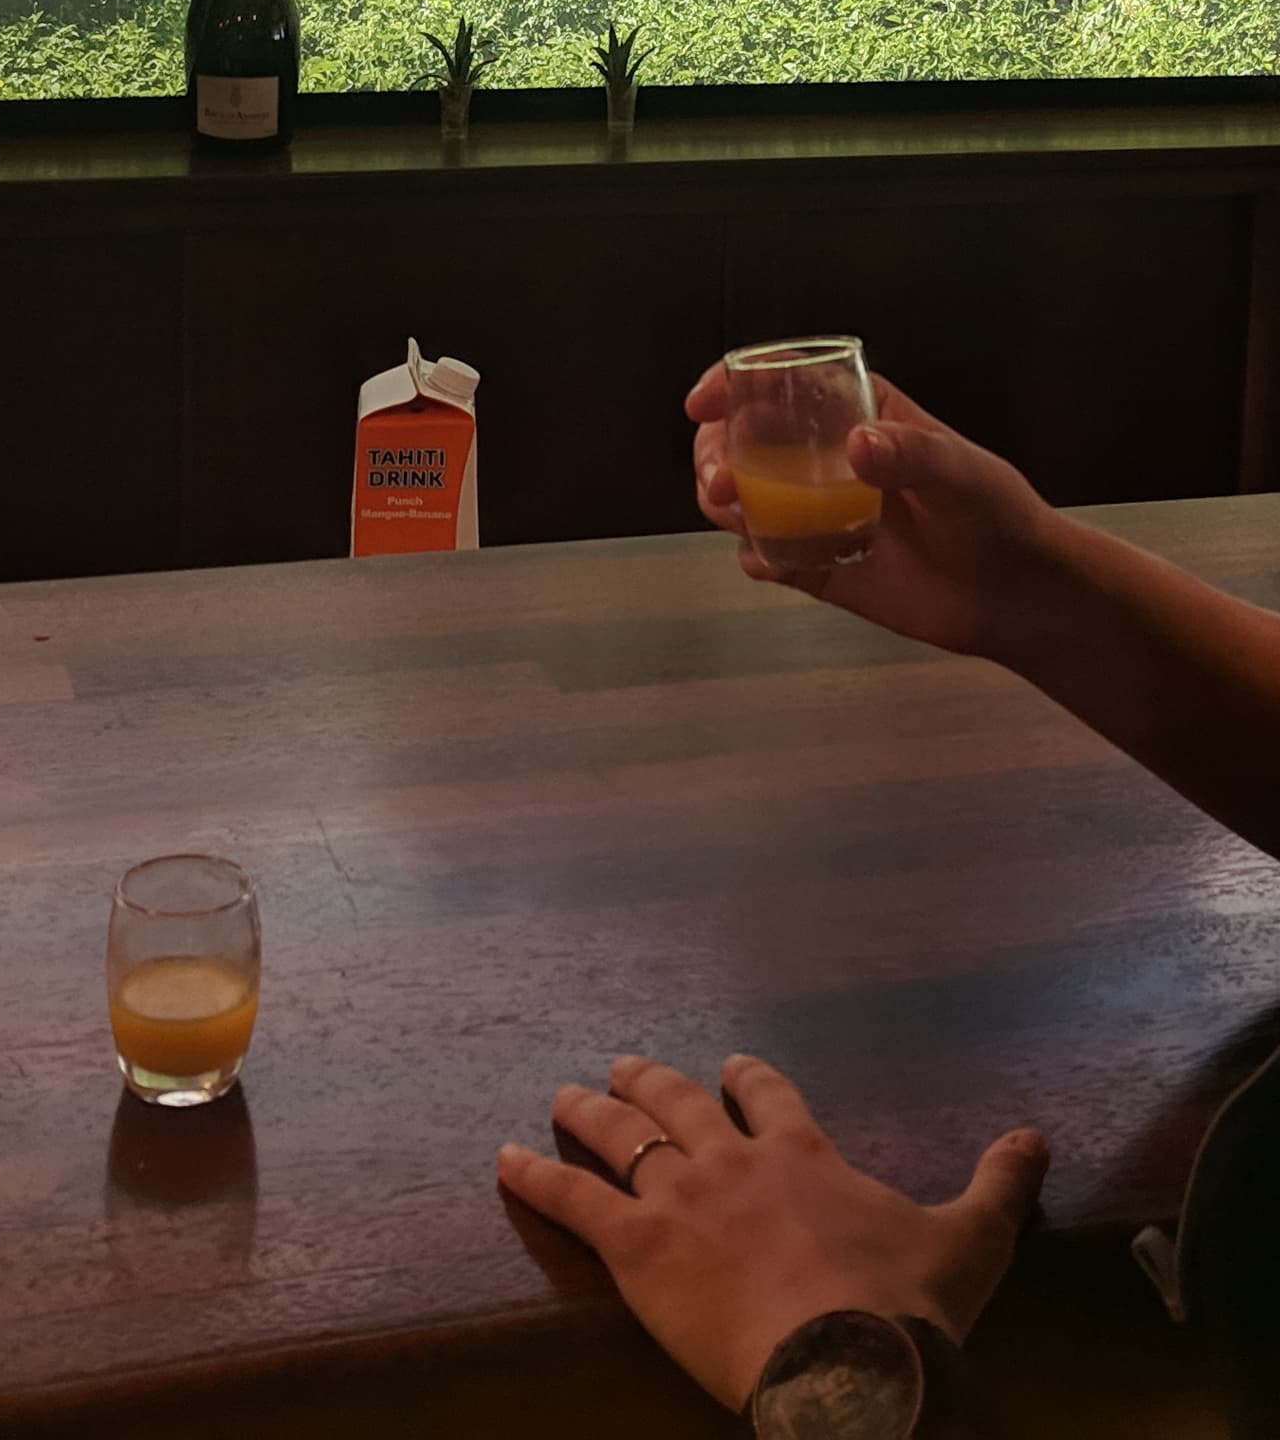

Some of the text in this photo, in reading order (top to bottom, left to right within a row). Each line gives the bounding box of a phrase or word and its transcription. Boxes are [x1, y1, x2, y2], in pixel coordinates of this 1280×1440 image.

[367, 447, 446, 468] TAHITI
[368, 469, 445, 488] DRINK
[387, 496, 424, 507] Punch
